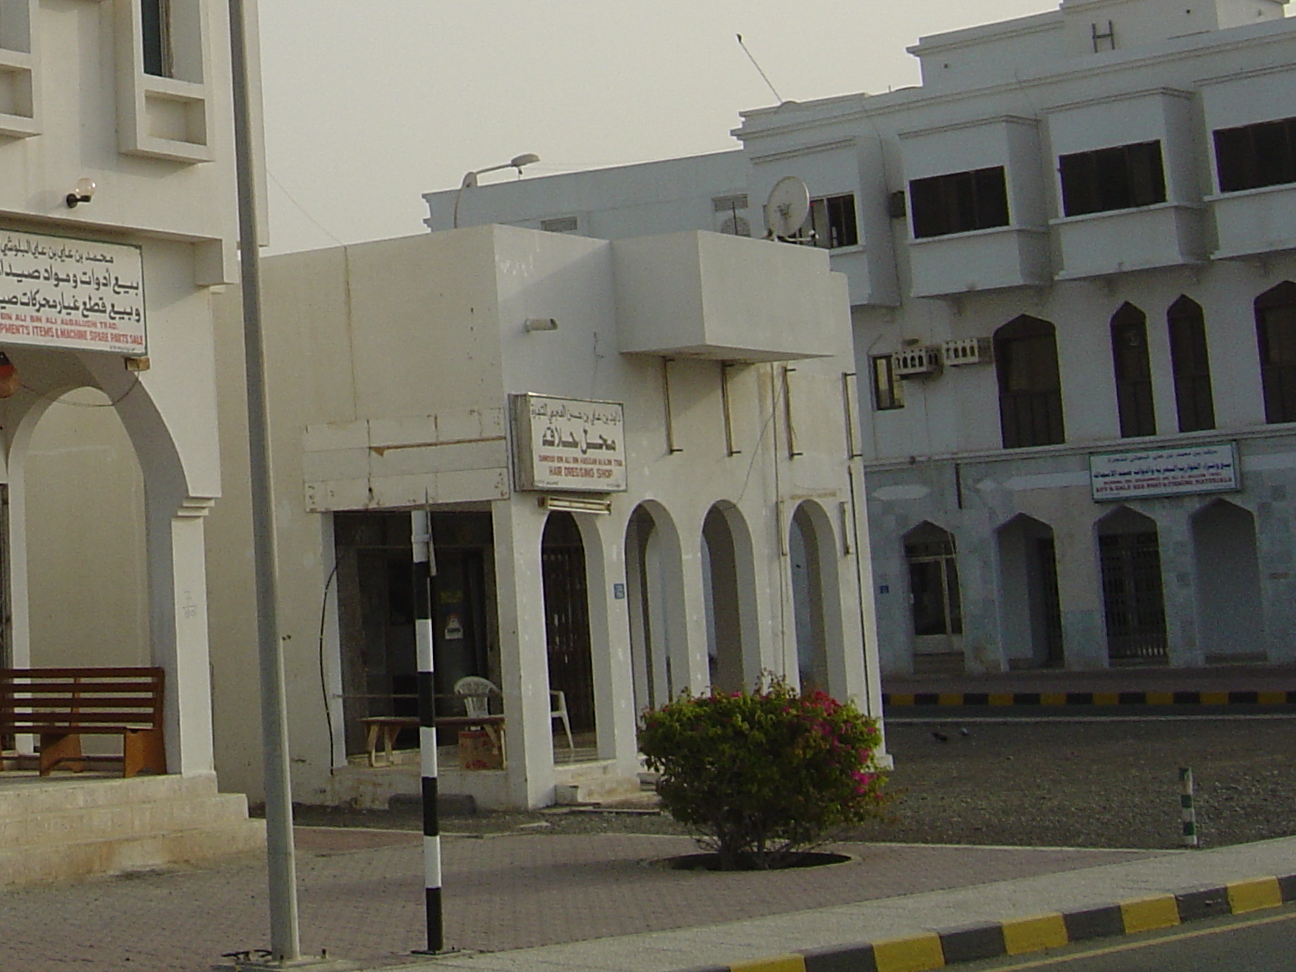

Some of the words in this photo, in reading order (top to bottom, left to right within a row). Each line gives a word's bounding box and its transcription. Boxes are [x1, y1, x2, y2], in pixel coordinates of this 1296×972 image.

[1, 235, 30, 257] البلوشي
[31, 241, 47, 259] علي
[48, 246, 57, 262] بن
[58, 244, 73, 262] علي
[75, 249, 84, 264] بن
[85, 251, 114, 264] محمد
[5, 263, 42, 283] صيد
[80, 268, 112, 291] أدوات
[113, 275, 140, 296] بيع
[19, 289, 58, 313] محركات
[57, 292, 80, 314] غيار
[81, 293, 107, 318] قطع
[0, 312, 12, 321] BIN
[15, 314, 26, 323] ALI
[29, 315, 42, 323] BIN
[45, 316, 57, 325] ALI
[32, 325, 54, 338] ITEMS
[89, 330, 110, 343] SPARE
[110, 332, 129, 345] PARTS
[129, 334, 143, 346] SALE
[542, 426, 579, 448] حلاقة
[580, 427, 616, 456] محل
